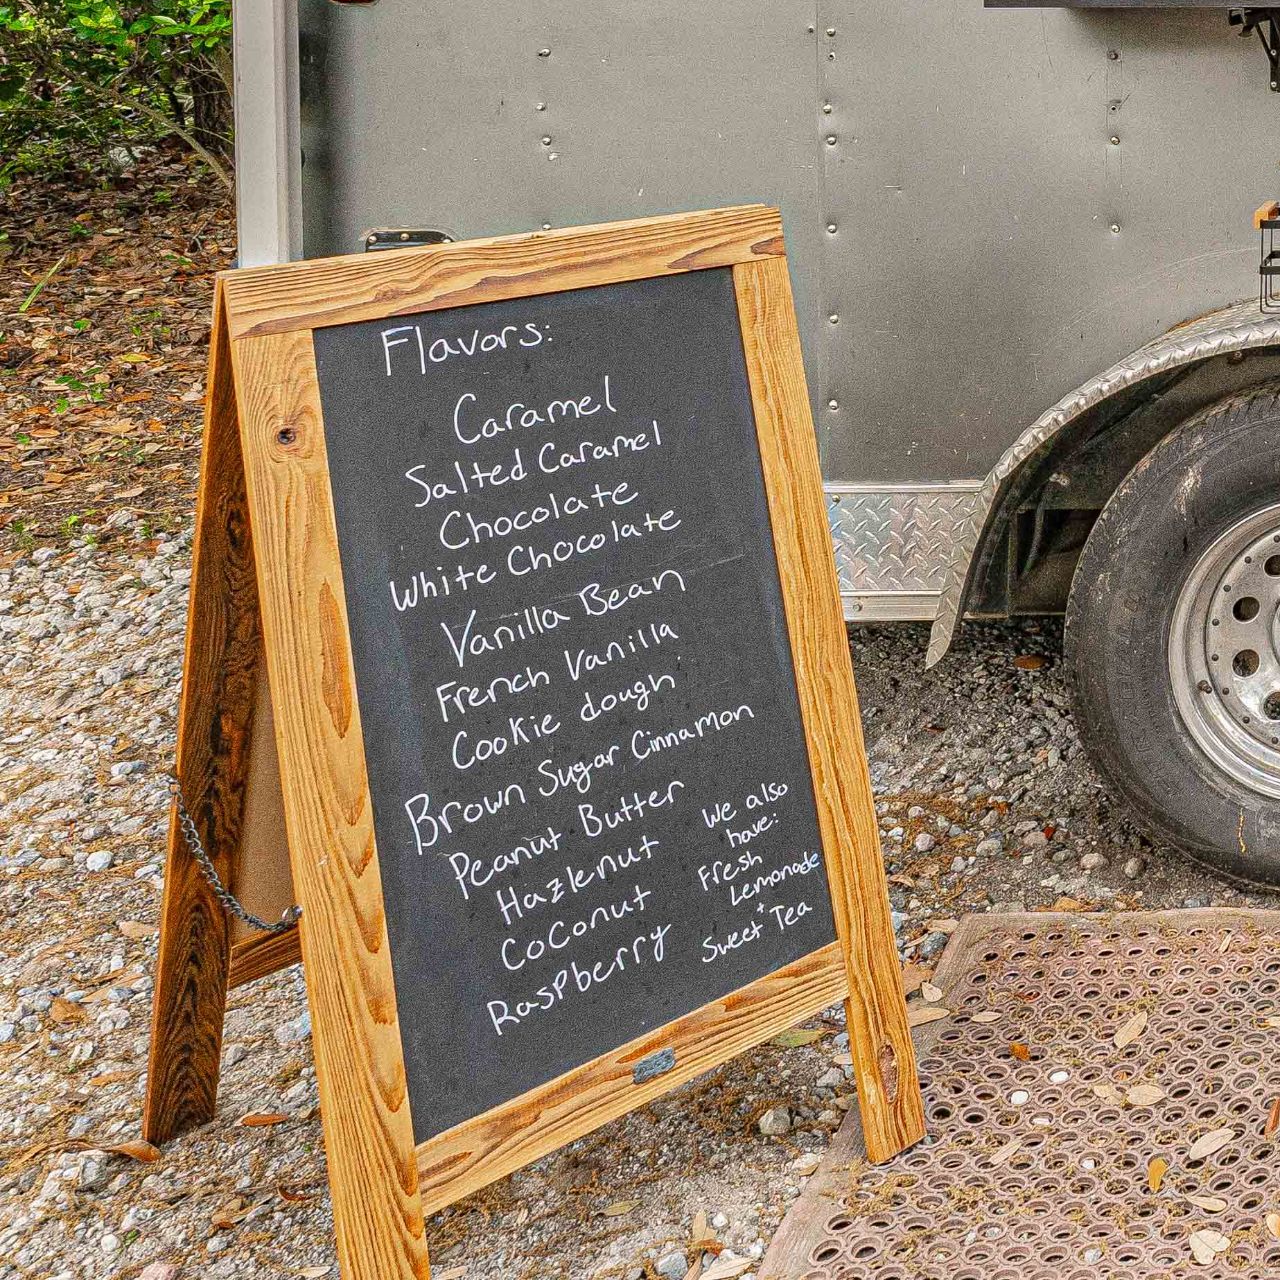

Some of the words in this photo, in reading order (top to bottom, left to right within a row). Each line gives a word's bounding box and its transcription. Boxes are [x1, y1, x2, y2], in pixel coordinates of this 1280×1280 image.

[381, 323, 553, 376] Flavors:
[454, 375, 617, 444] Caramel
[405, 448, 527, 508] Salted
[538, 420, 661, 473] Caramel
[439, 482, 639, 550] Chocolate
[389, 564, 497, 612] White
[507, 510, 682, 576] Chocolate
[441, 606, 570, 668] Vanilla
[579, 569, 686, 616] Bean
[436, 667, 550, 723] French
[564, 623, 679, 681] Vanilla
[580, 673, 676, 722] dough
[404, 783, 526, 856] Brown
[538, 745, 620, 797] Sugar
[631, 704, 754, 760] Cinnamon
[702, 801, 737, 830] We
[746, 782, 789, 811] also
[449, 827, 562, 900] Peanut
[579, 781, 685, 838] Butter
[726, 812, 780, 848] have:
[497, 835, 660, 925] Hazlenut
[698, 851, 762, 892] Fresh
[730, 850, 821, 907] Lemonade
[701, 920, 764, 963] Sweet
[771, 900, 813, 932] Tea
